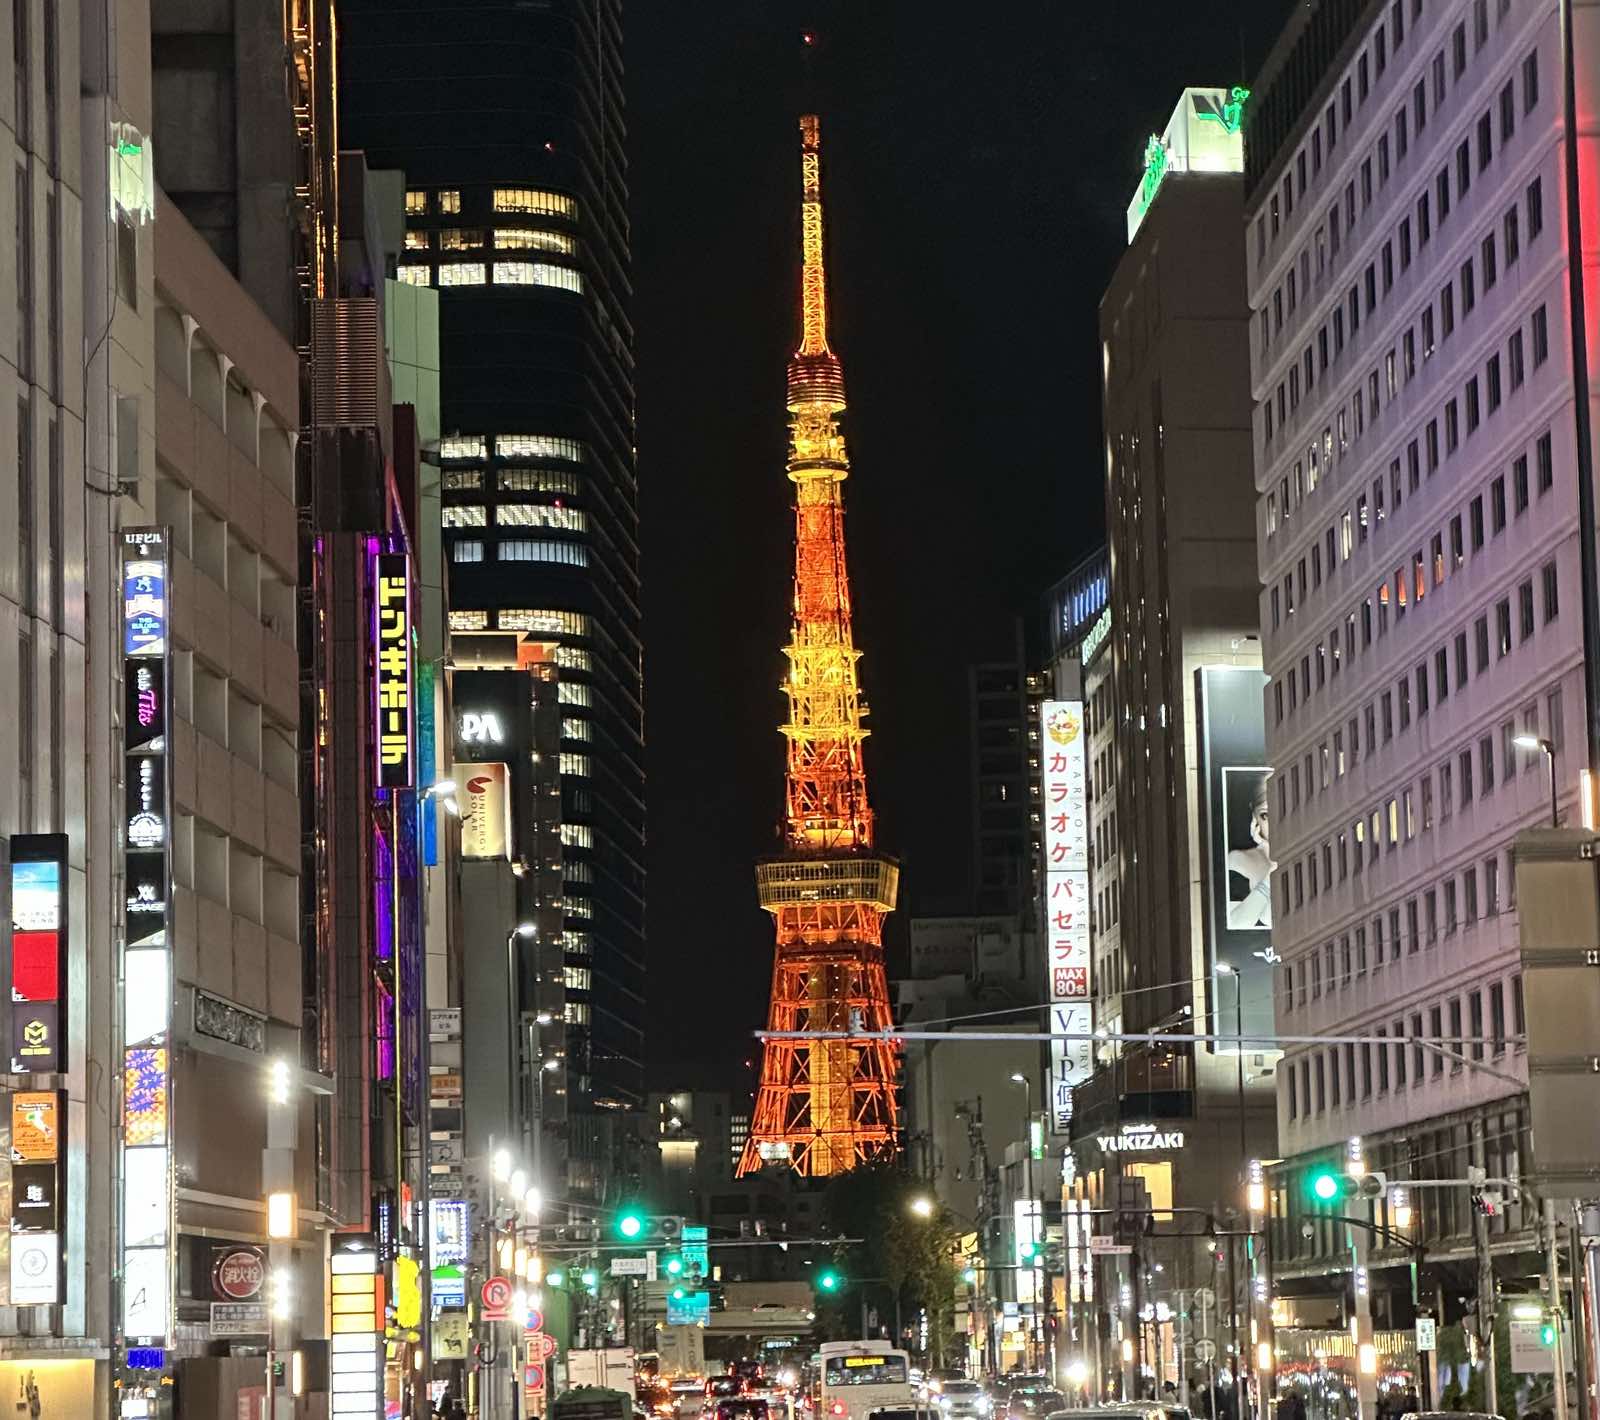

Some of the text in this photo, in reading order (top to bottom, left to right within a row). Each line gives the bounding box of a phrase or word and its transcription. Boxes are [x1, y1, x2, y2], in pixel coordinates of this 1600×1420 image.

[138, 668, 151, 690] club
[379, 576, 408, 765] ドン・キホーテ
[470, 795, 478, 832] SOLAR
[1049, 752, 1072, 863] カラオケ
[1072, 756, 1084, 858] KARAOKE
[1052, 879, 1074, 960] パセラ
[1076, 883, 1087, 957] PASELA
[1056, 969, 1084, 980] MAX
[1056, 981, 1085, 996] 80名
[1078, 1016, 1089, 1070] LUURY
[1097, 1133, 1184, 1152] YUKIZAKI
